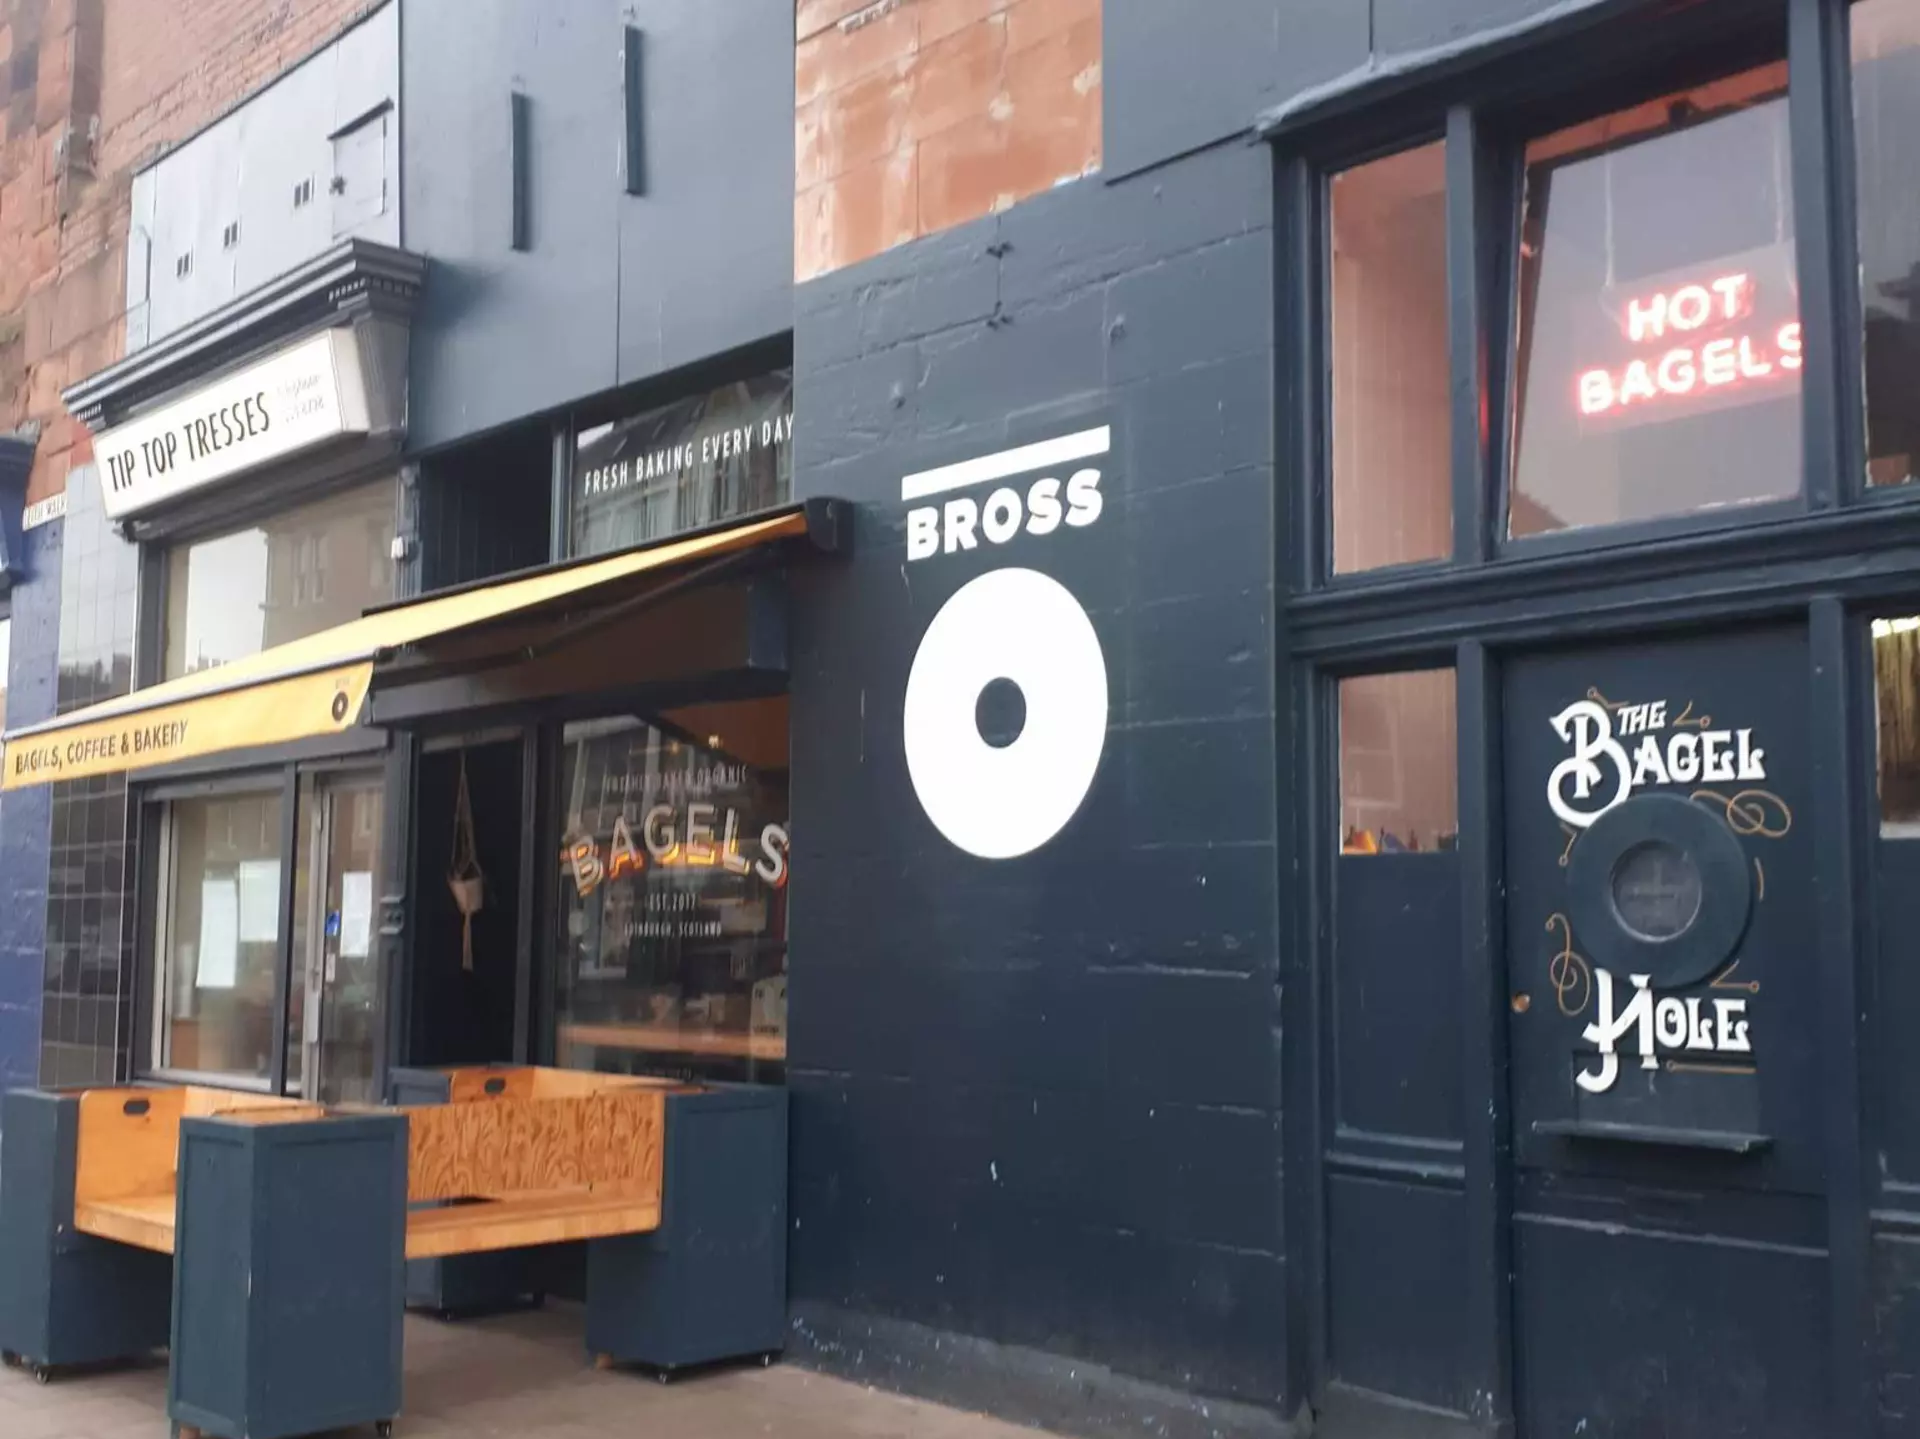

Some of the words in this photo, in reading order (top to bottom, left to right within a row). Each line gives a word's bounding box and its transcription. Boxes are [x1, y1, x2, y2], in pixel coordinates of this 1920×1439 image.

[1628, 273, 1747, 342] HOT
[1580, 322, 1802, 414] BAGELS
[107, 451, 136, 493] TIP
[141, 434, 179, 479] TOP
[183, 391, 271, 462] TRESSES
[584, 461, 628, 496] FRESH
[636, 443, 693, 483] BAKING
[702, 425, 752, 463] EVERY
[762, 412, 794, 447] DAY
[907, 468, 1103, 562] BROSS
[67, 734, 117, 765] COFFEE
[121, 732, 130, 755] &
[134, 719, 188, 752] BAKERY
[1617, 700, 1667, 736] THE
[1547, 700, 1766, 828] BAGEL
[569, 803, 789, 893] BAGELS
[1575, 968, 1751, 1093] HOLE
